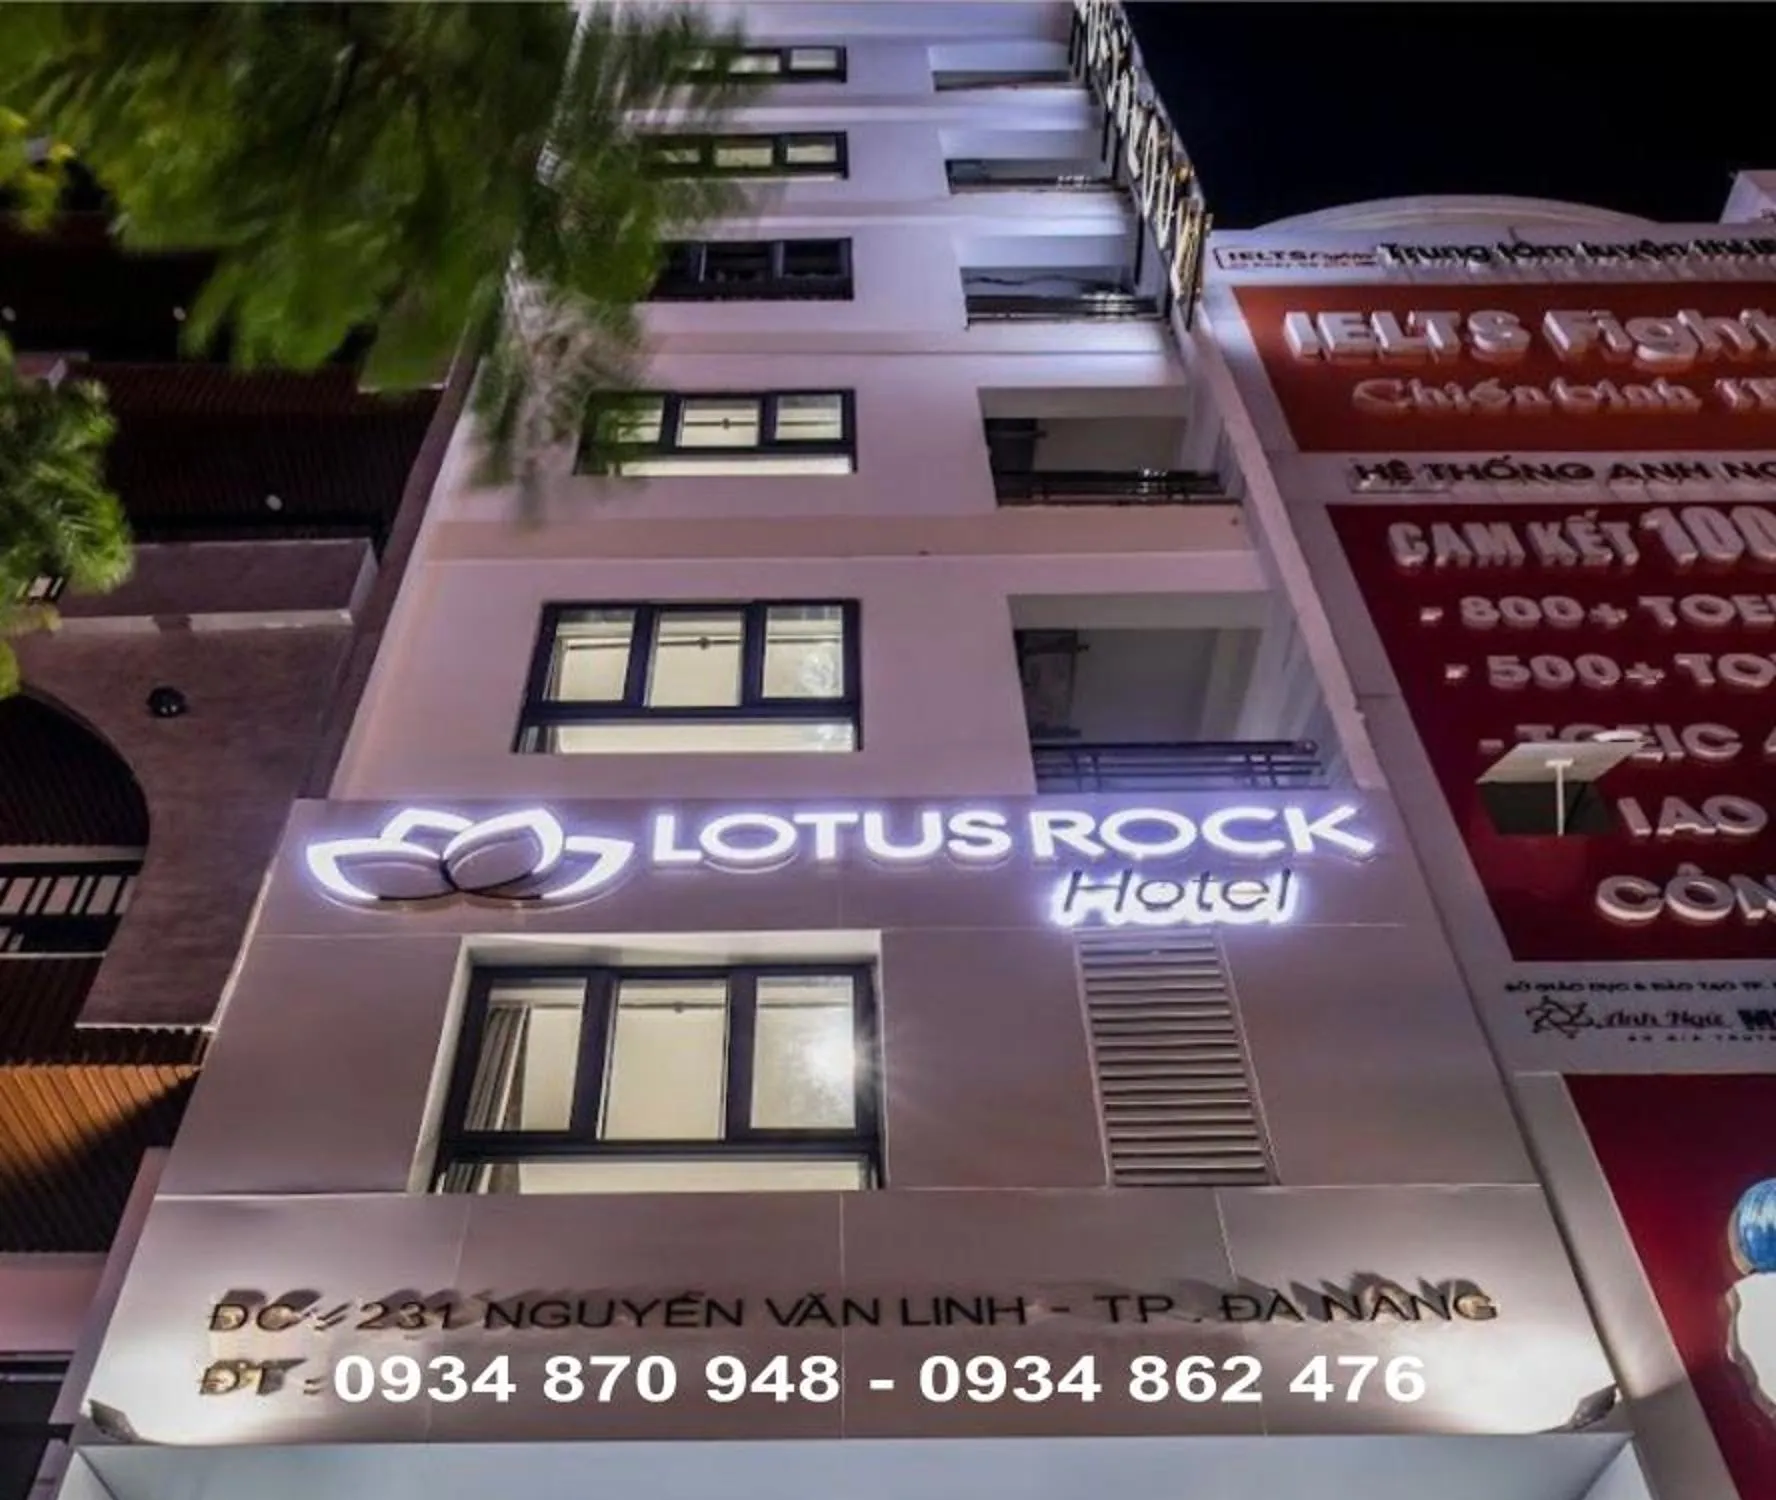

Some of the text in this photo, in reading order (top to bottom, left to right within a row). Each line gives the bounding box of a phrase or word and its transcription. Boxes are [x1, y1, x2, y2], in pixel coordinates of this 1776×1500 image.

[1285, 310, 1531, 357] IELTS
[1423, 455, 1595, 481] THỐNG
[1609, 462, 1712, 480] ANH
[1388, 521, 1526, 567] CAM
[1527, 509, 1640, 567] KẾT
[1674, 652, 1776, 687] TO
[653, 804, 1377, 863] LOTUS ROCK
[1617, 795, 1768, 836] IAO
[1058, 868, 1297, 925] Hotel
[356, 1301, 454, 1331] 231
[766, 1293, 881, 1328] VĂN
[900, 1296, 1027, 1327] LINH
[1219, 1289, 1304, 1322] ĐÀ
